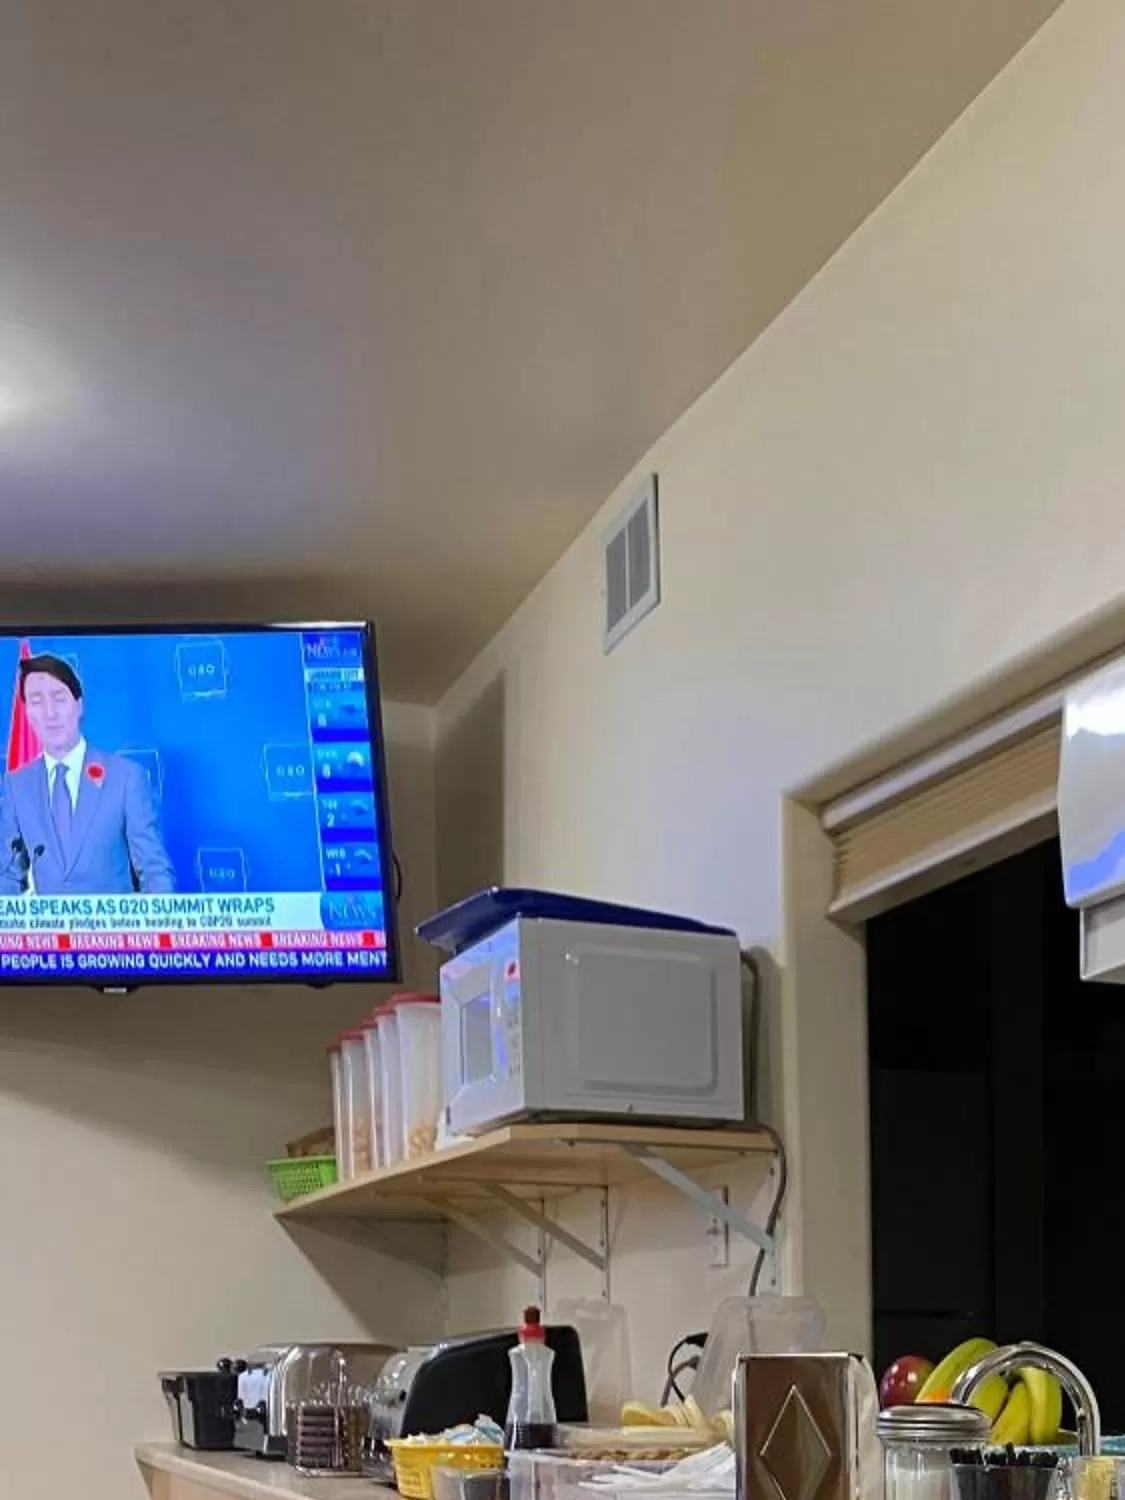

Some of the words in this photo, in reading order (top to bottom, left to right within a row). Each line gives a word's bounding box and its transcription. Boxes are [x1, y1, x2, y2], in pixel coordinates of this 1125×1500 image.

[30, 898, 92, 915] SPEAKS
[96, 898, 117, 914] AS
[152, 897, 215, 913] SUMMIT
[218, 896, 275, 912] WRAPS
[2, 954, 57, 969] PEOPLE
[61, 954, 75, 968] IS
[78, 953, 145, 968] GROWING
[149, 953, 210, 968] QUICKLY
[215, 952, 246, 968] AND
[249, 951, 298, 967] NEEDS
[301, 951, 342, 967] MORE
